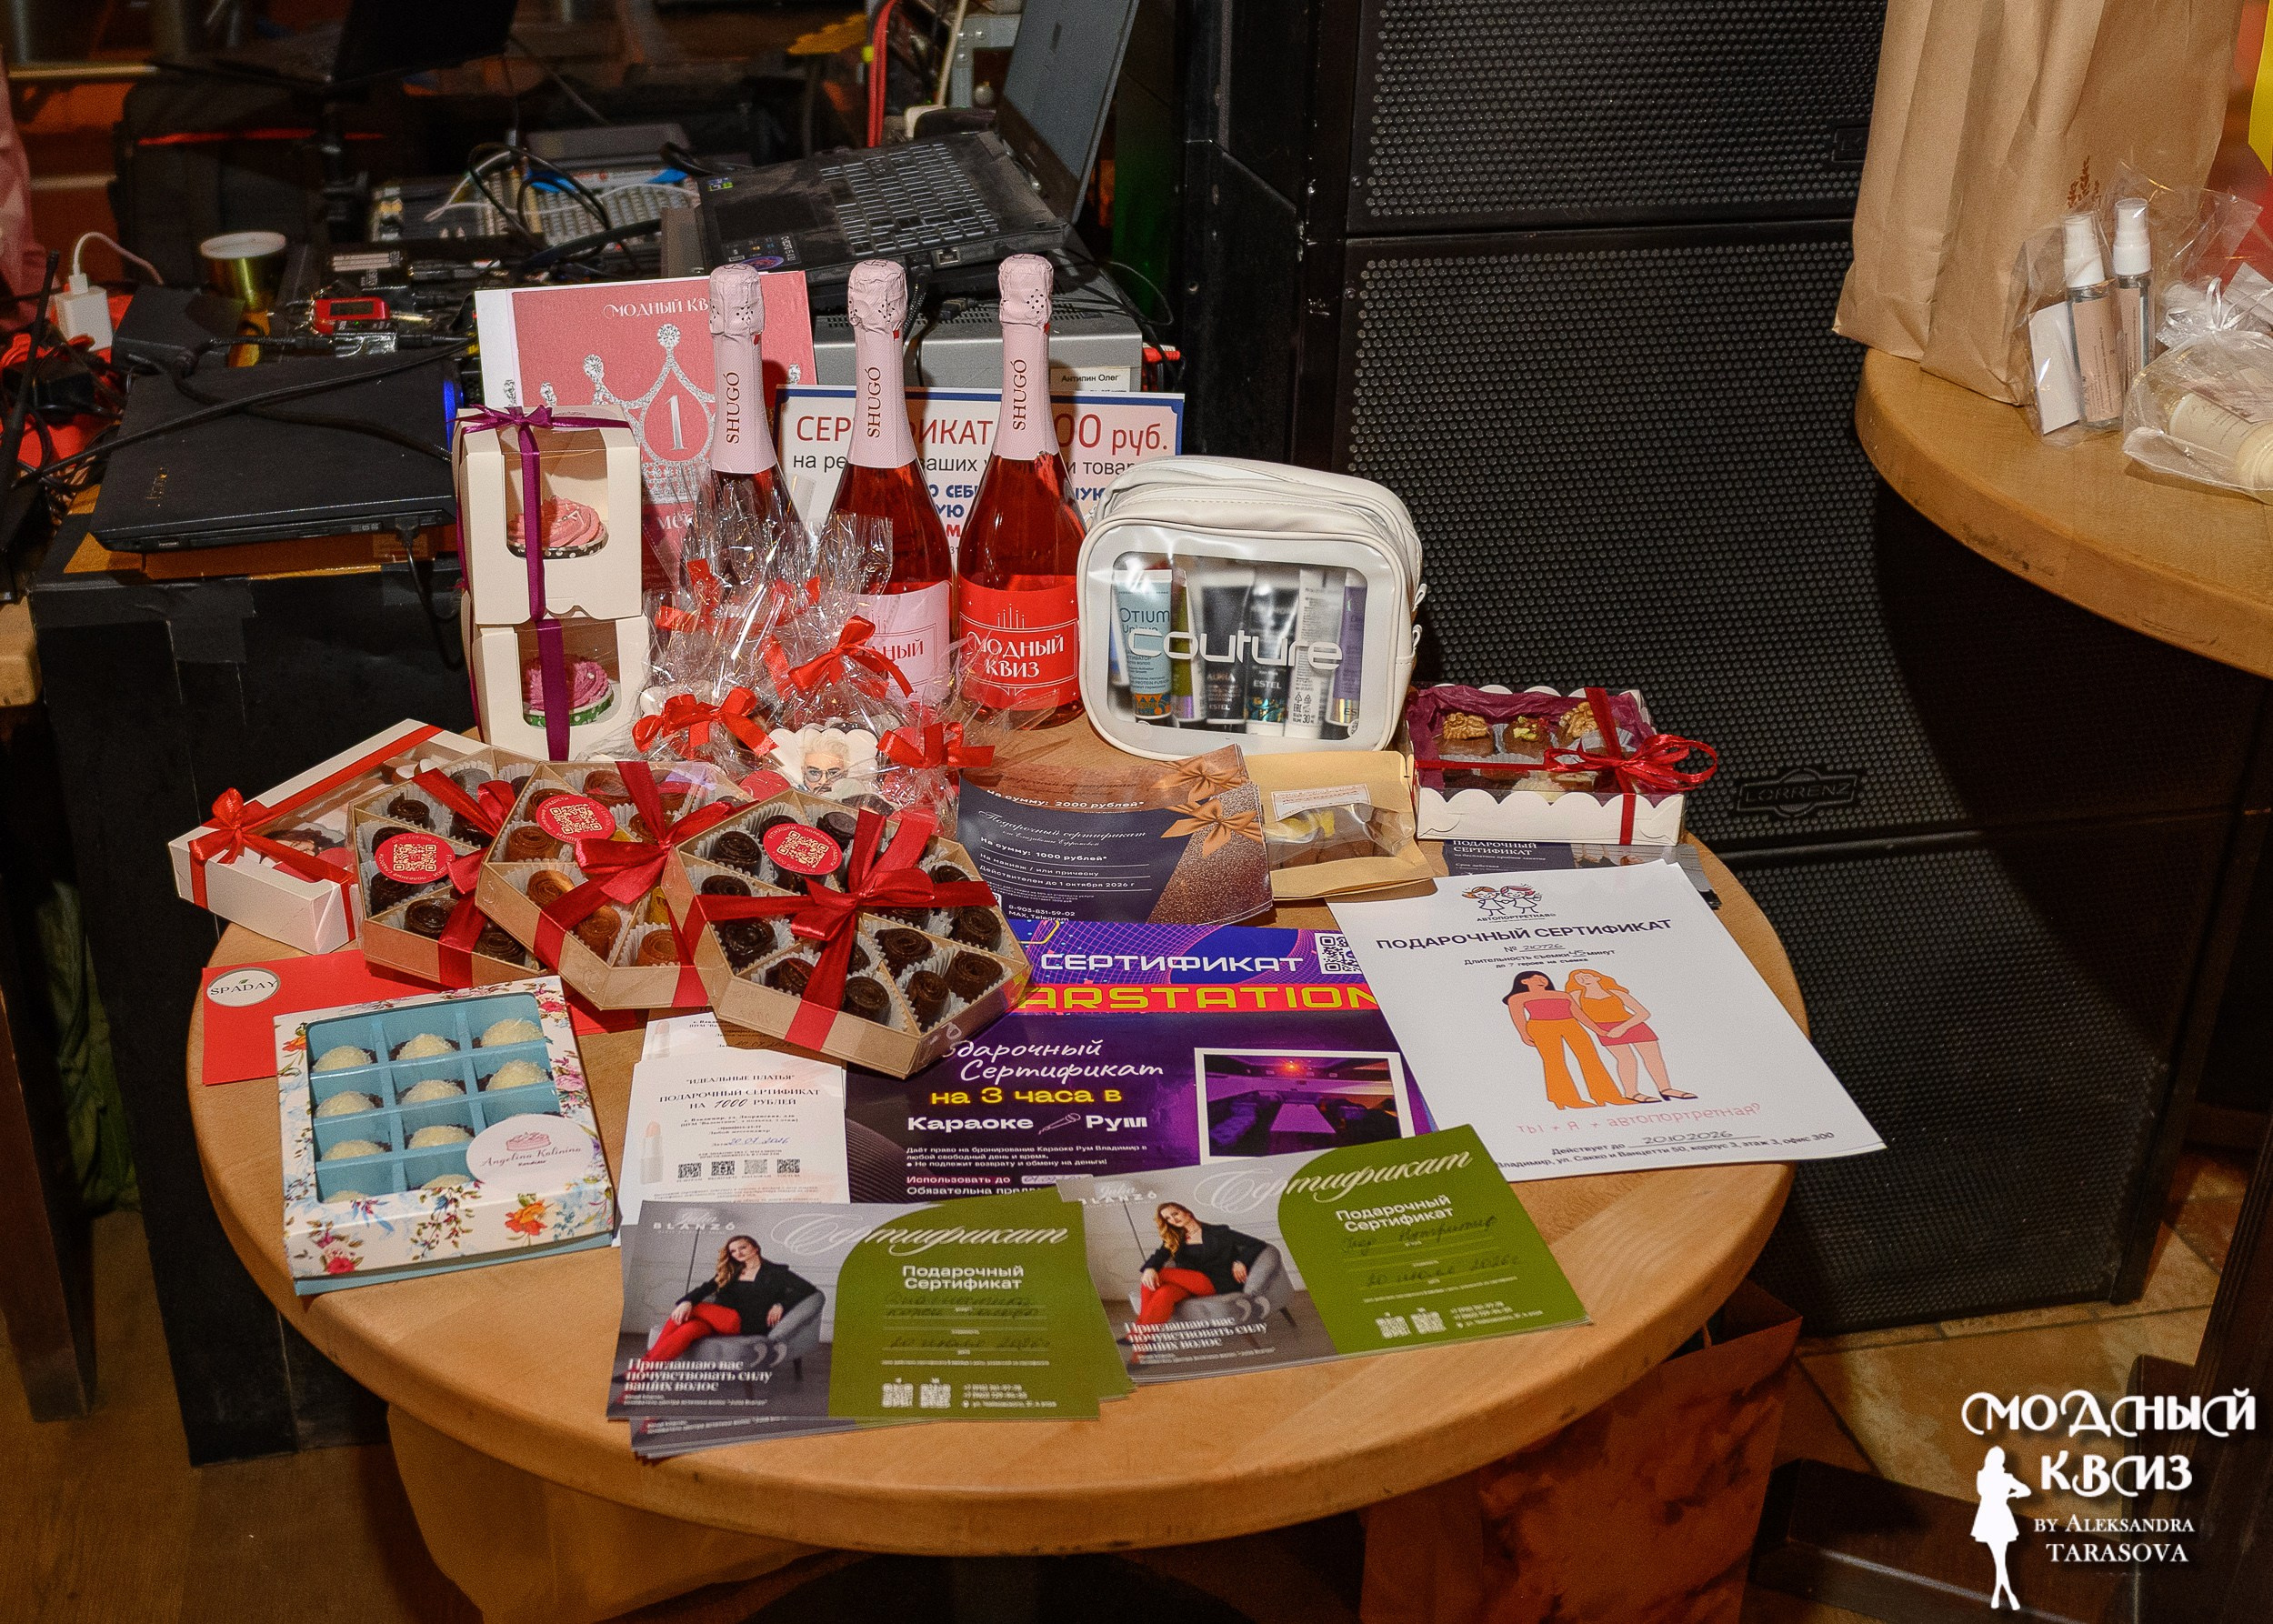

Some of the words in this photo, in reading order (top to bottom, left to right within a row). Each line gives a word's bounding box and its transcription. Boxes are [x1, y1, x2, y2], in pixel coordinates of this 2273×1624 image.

[604, 298, 682, 319] МОДНЫЙ
[687, 297, 709, 311] КВ
[1098, 374, 1119, 382] Олег
[864, 366, 882, 438] SHUGÓ
[1010, 358, 1028, 431] SHUGÓ
[723, 371, 740, 444] SHUGÓ
[1111, 423, 1168, 456] руб.
[793, 455, 818, 469] на
[966, 631, 1064, 659] МОДНЫЙ
[1127, 629, 1343, 670] couture
[986, 659, 1039, 678] КВИЗ
[1005, 794, 1048, 806] сумму:
[1746, 783, 1851, 802] LORRENZ
[978, 810, 1059, 837] Подарочный
[996, 842, 1031, 856] сумму:
[1453, 840, 1537, 849] ПОДАРОЧНЫЙ
[1453, 847, 1532, 856] СЕРТИФИКАТ
[1376, 927, 1531, 950] ПОДАРОЧНЫЙ
[1535, 919, 1672, 938] СЕРТИФИКАТ
[1041, 953, 1304, 973] СЕРТИФИКАТ
[1464, 954, 1532, 965] Длительность
[210, 979, 277, 995] SPADAY
[1017, 987, 1378, 1009] ARSTATION
[951, 1039, 1104, 1063] дарочный
[960, 1059, 1164, 1085] Сертификат
[659, 1088, 742, 1103] ПОДАРОЧНЫЙ
[753, 1098, 796, 1107] РУБЛЕЙ
[930, 1092, 970, 1105] на
[981, 1087, 1003, 1104] 3
[1015, 1090, 1095, 1104] часа
[1105, 1089, 1122, 1102] в
[907, 1117, 1034, 1133] Караоке
[1086, 1115, 1147, 1132] Рум
[1551, 1143, 1608, 1156] Действует
[906, 1176, 992, 1184] Использовать
[995, 1176, 1011, 1186] до
[1336, 1194, 1452, 1221] Подарочный
[1344, 1207, 1454, 1233] Сертификат
[902, 1265, 1024, 1278] Подарочный
[904, 1277, 1022, 1292] Сертификат
[719, 1359, 744, 1370] вас
[674, 1381, 719, 1392] волос
[737, 1371, 773, 1384] силу
